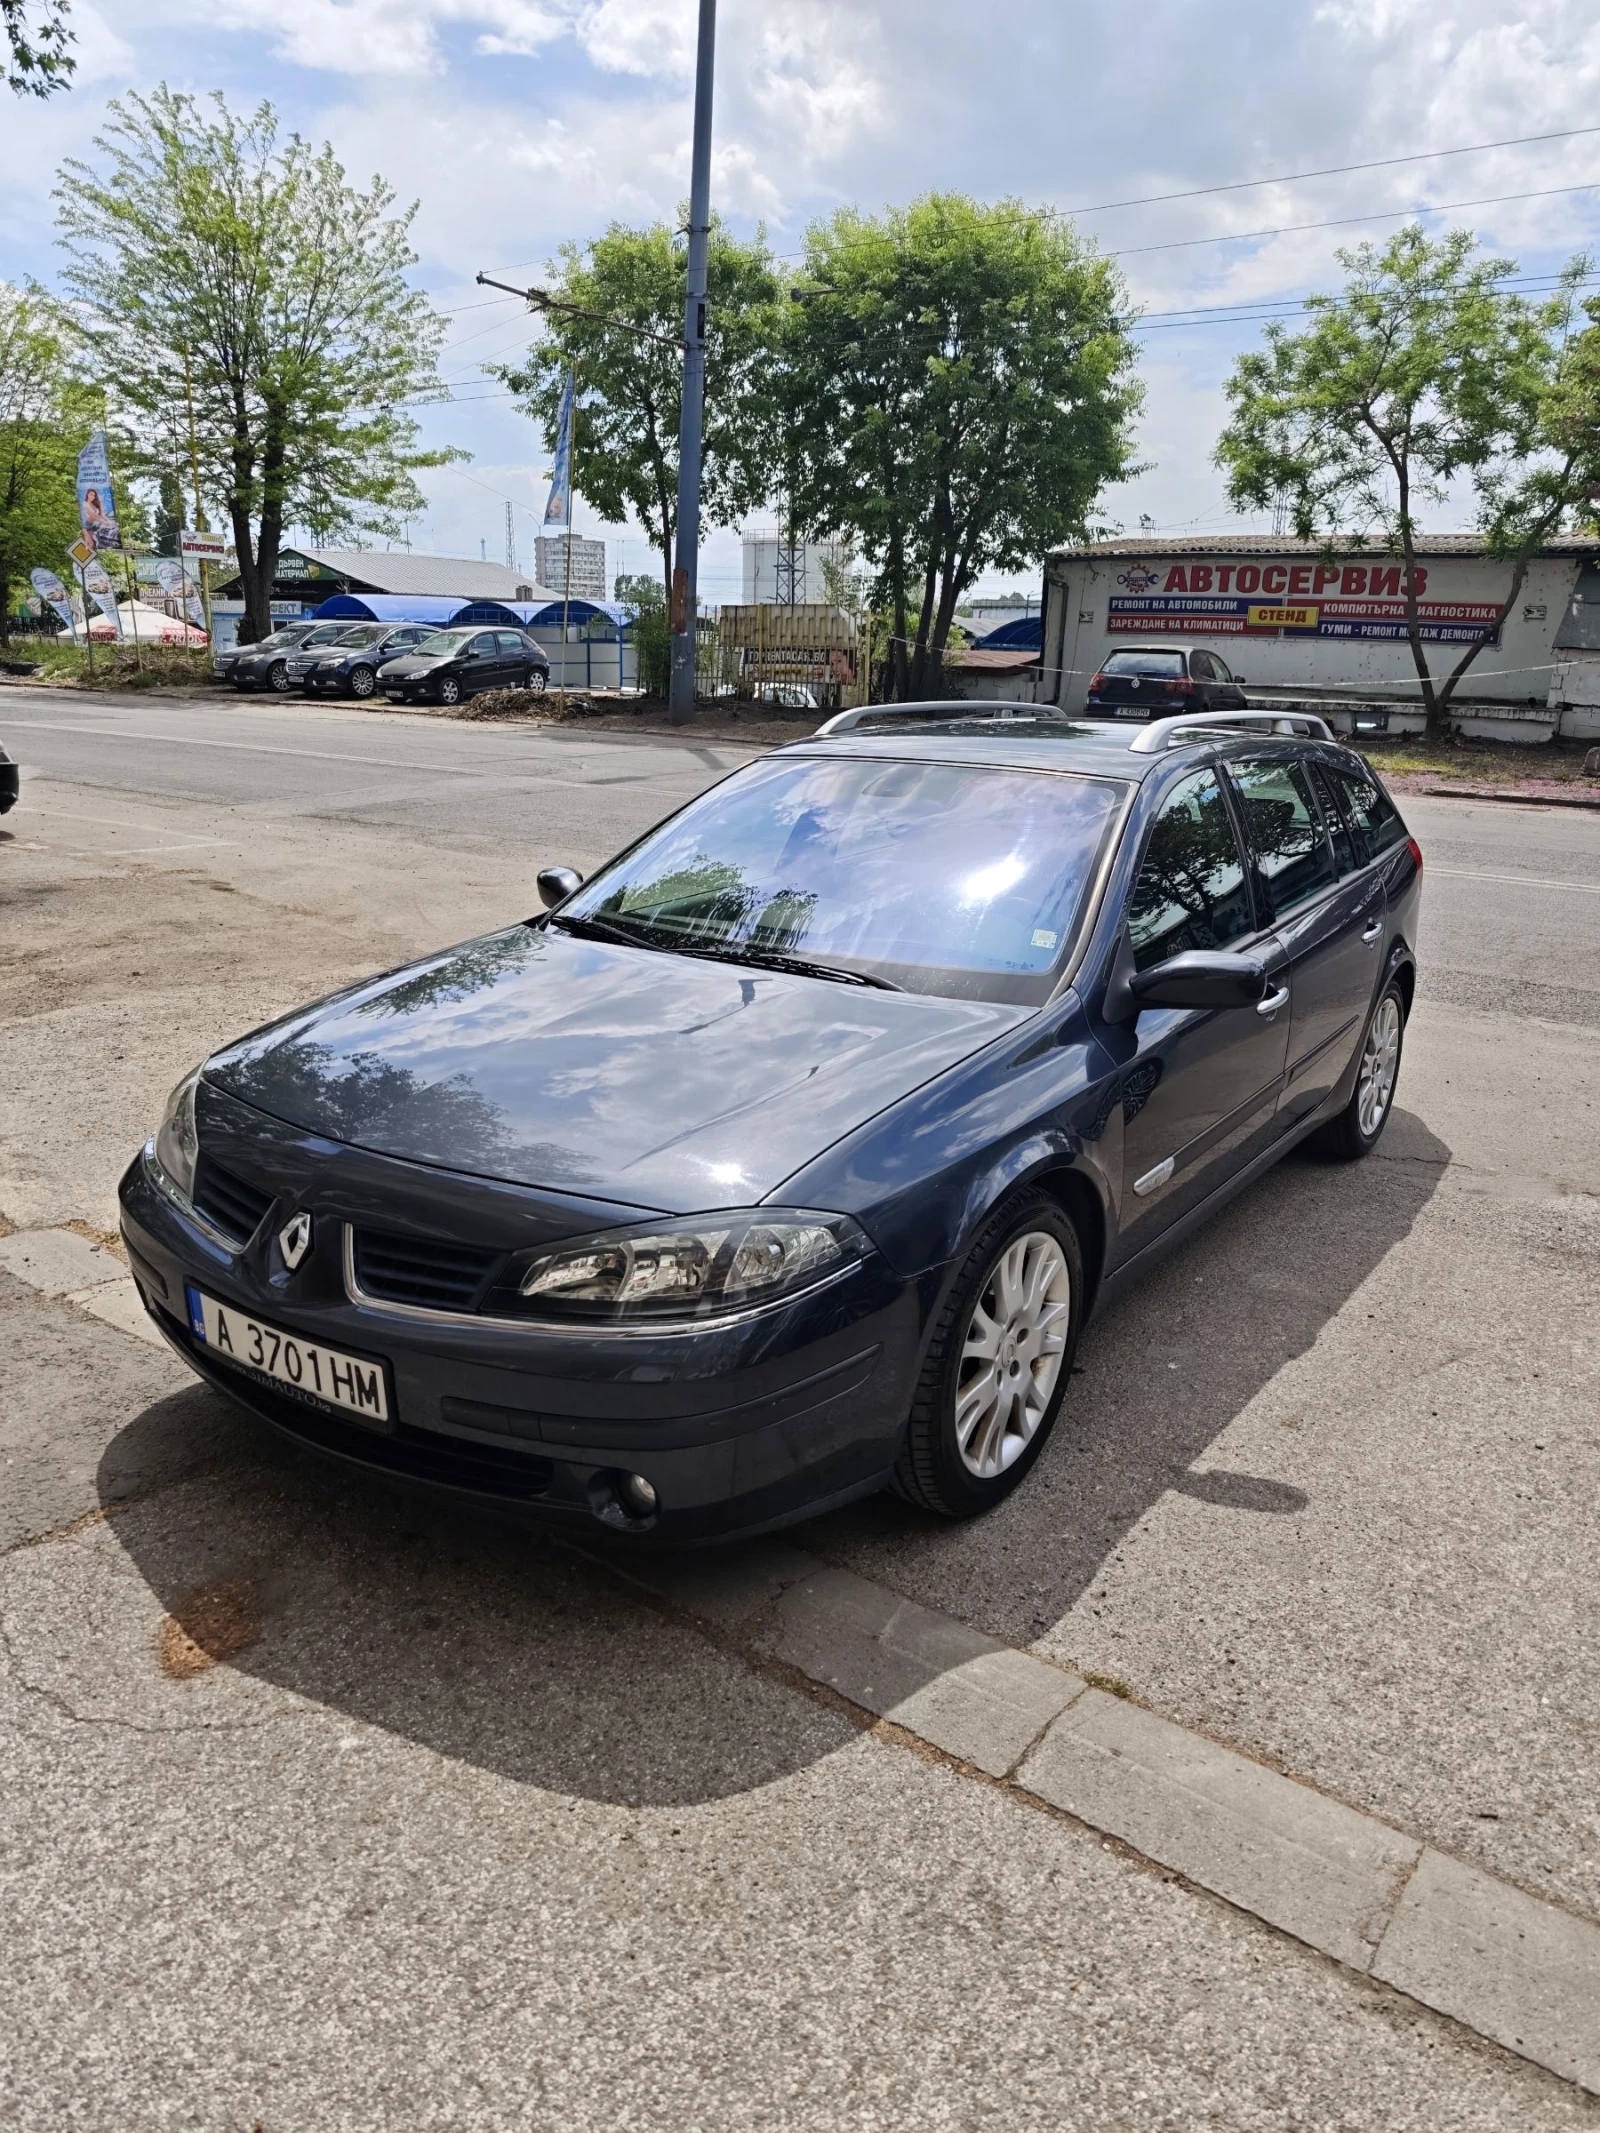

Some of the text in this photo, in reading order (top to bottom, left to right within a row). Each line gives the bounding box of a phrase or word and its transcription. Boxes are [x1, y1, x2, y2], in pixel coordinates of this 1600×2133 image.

[278, 559, 304, 569] ДЪРВЕН
[1163, 564, 1428, 597] АВТОСЕРВИЗ
[1111, 599, 1238, 611] РЕМОНТ НА АВТОМОБИЛИ
[1323, 603, 1497, 618] КОМПЮТЪРНА ИАГНОСТИКА
[1257, 608, 1308, 623] СТЕНД
[1110, 618, 1244, 633] ЗАРЕЖДАНЕ НА КЛИМАТИЦИ
[1320, 624, 1352, 635] ГУМИ
[1361, 625, 1397, 637] РЕМОНТ
[1398, 626, 1439, 639] МТАЖ
[1440, 628, 1494, 641] ДЕМОНТА
[218, 1308, 234, 1354] A
